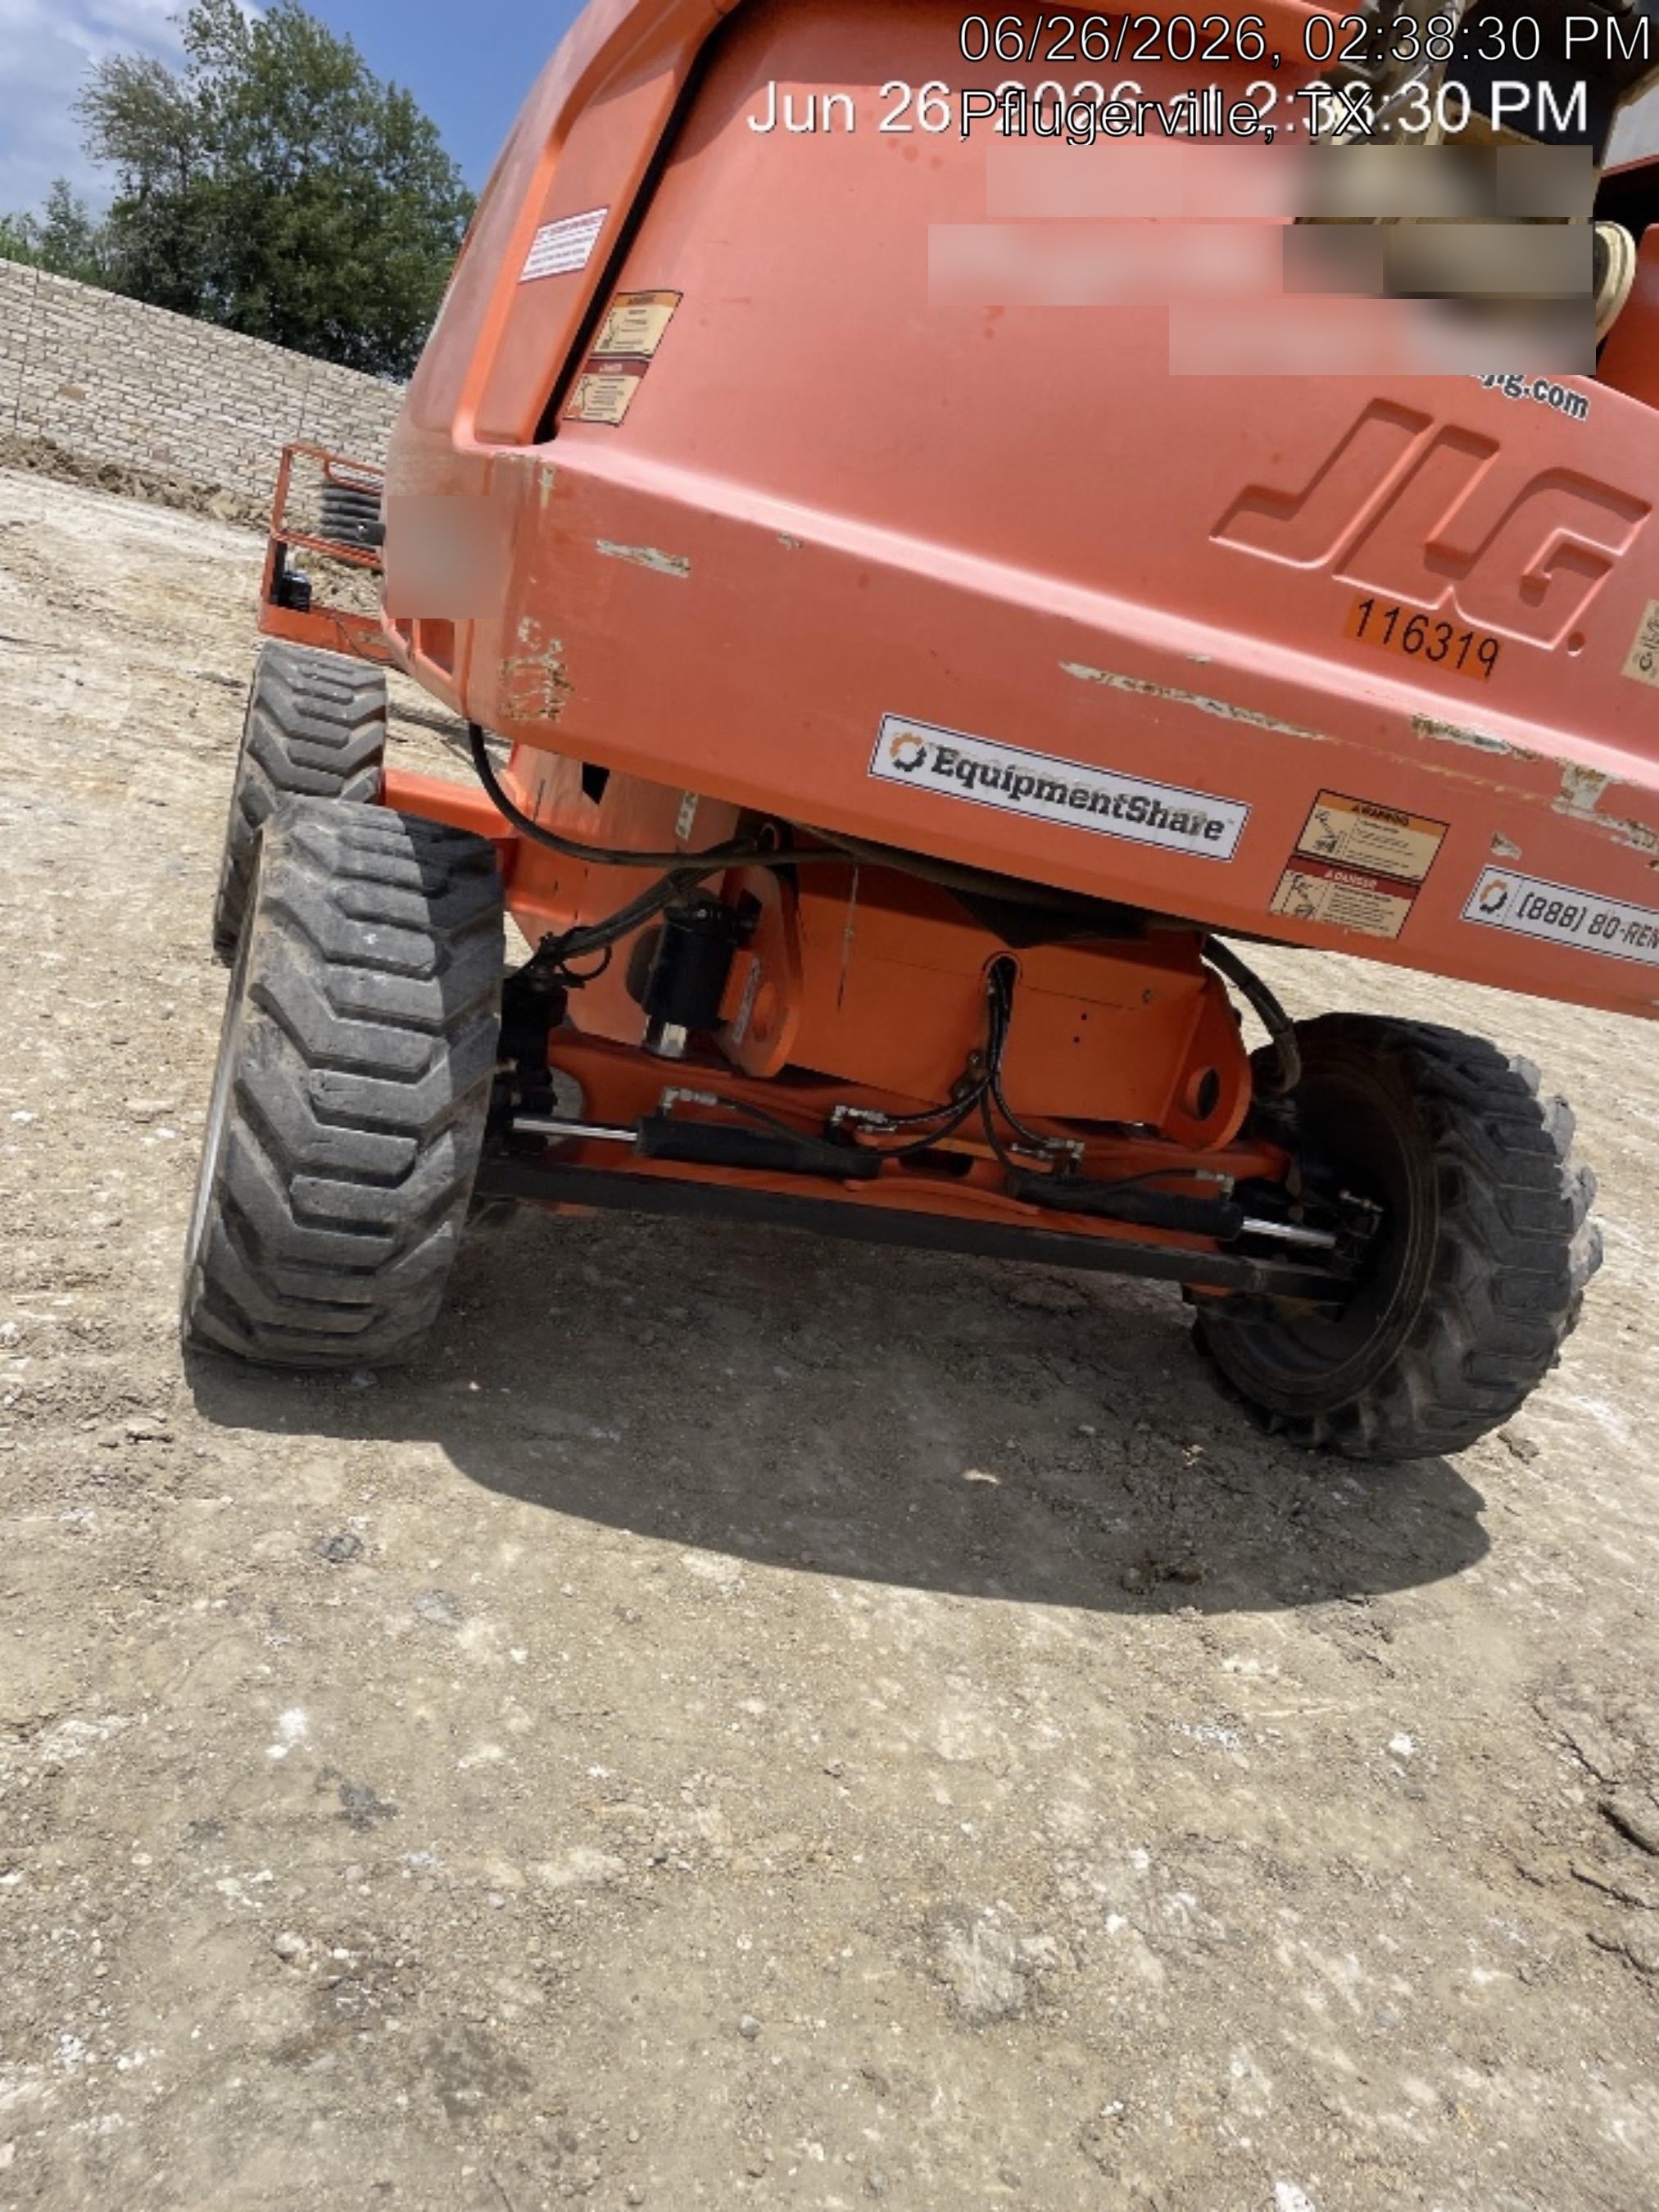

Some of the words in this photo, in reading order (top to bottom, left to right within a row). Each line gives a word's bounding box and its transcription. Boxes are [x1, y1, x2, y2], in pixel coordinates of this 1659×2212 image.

[1209, 397, 1652, 650] JLG
[1356, 598, 1501, 678] 116319
[929, 743, 1226, 842] EquipmentShare
[1516, 891, 1587, 932] (888)
